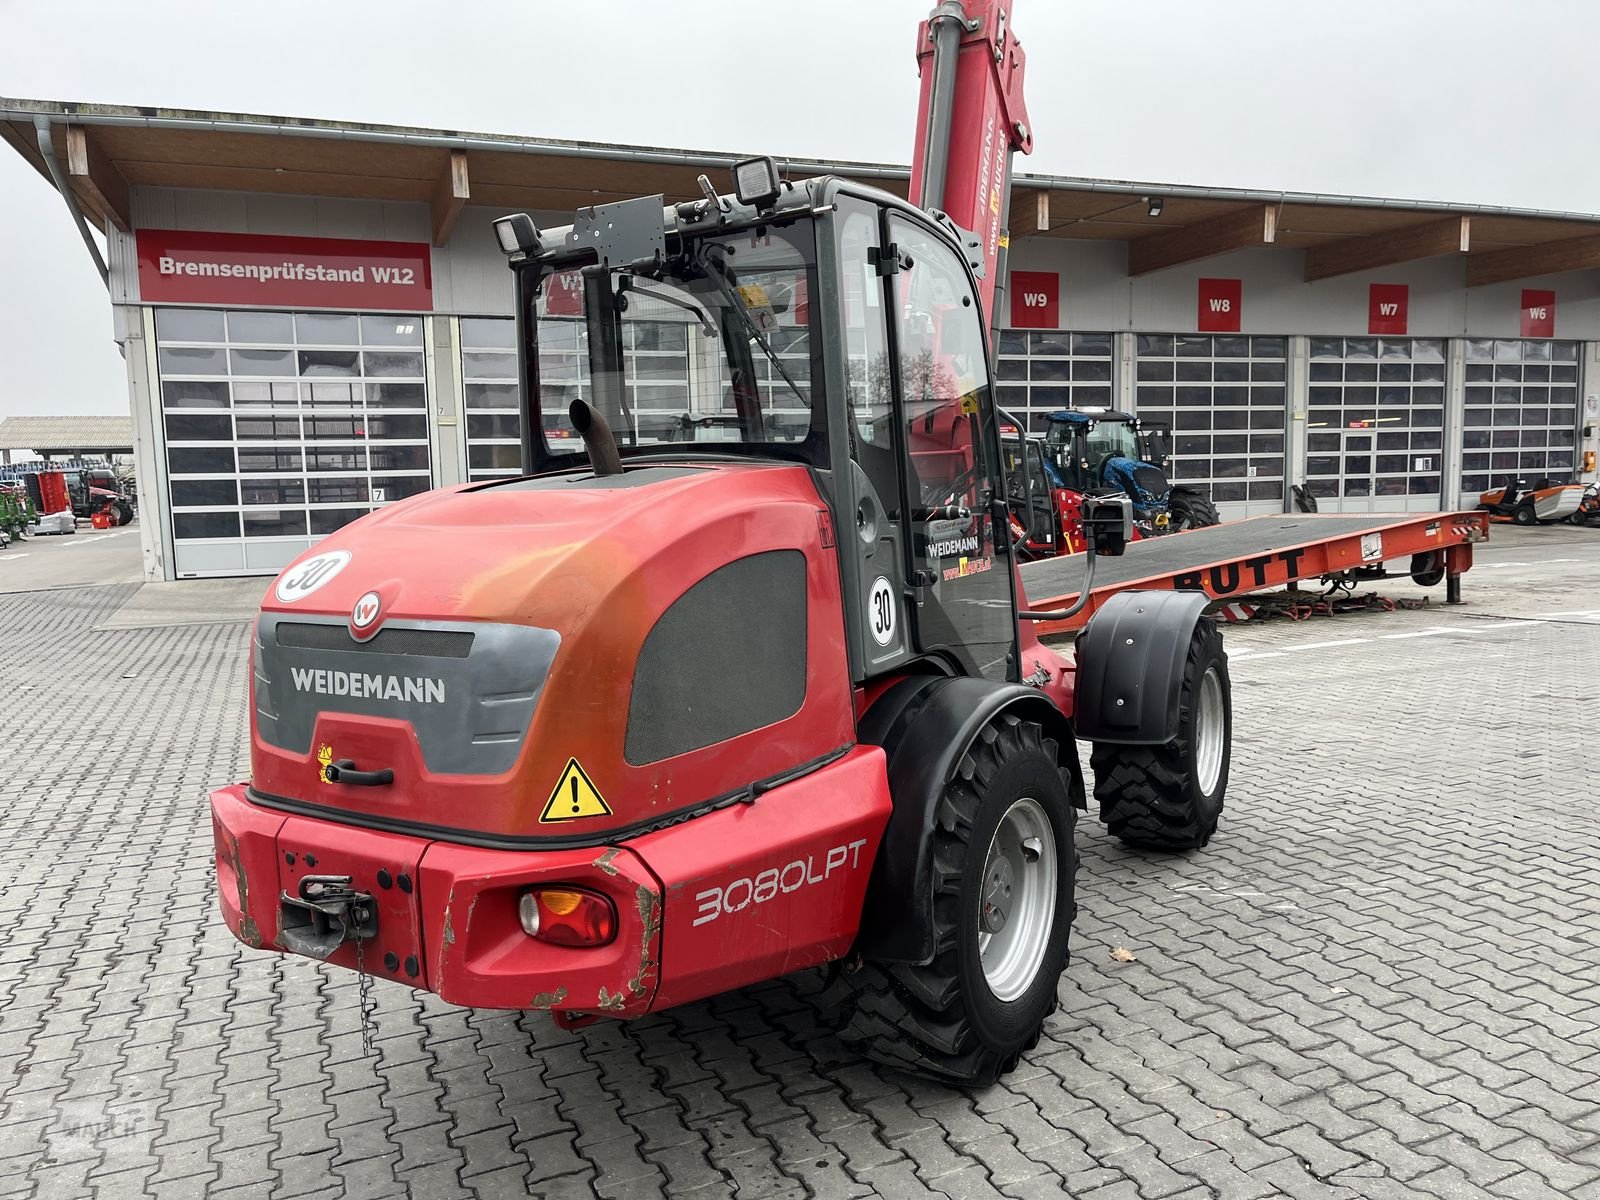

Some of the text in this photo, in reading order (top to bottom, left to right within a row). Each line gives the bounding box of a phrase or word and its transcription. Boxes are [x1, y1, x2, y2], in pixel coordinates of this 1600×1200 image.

[158, 256, 415, 286] Bremsenprüfstand W12
[560, 274, 585, 291] W1
[1023, 293, 1048, 307] W9
[1209, 298, 1231, 313] W8
[1380, 303, 1398, 316] W7
[1530, 307, 1547, 320] W6
[374, 490, 382, 500] 7
[928, 535, 979, 558] WEIDEMANN
[285, 558, 341, 591] 30
[1173, 548, 1305, 595] BUTT
[874, 588, 892, 634] 30
[290, 667, 446, 704] WEIDEMANN
[692, 838, 867, 928] 3080LPT
